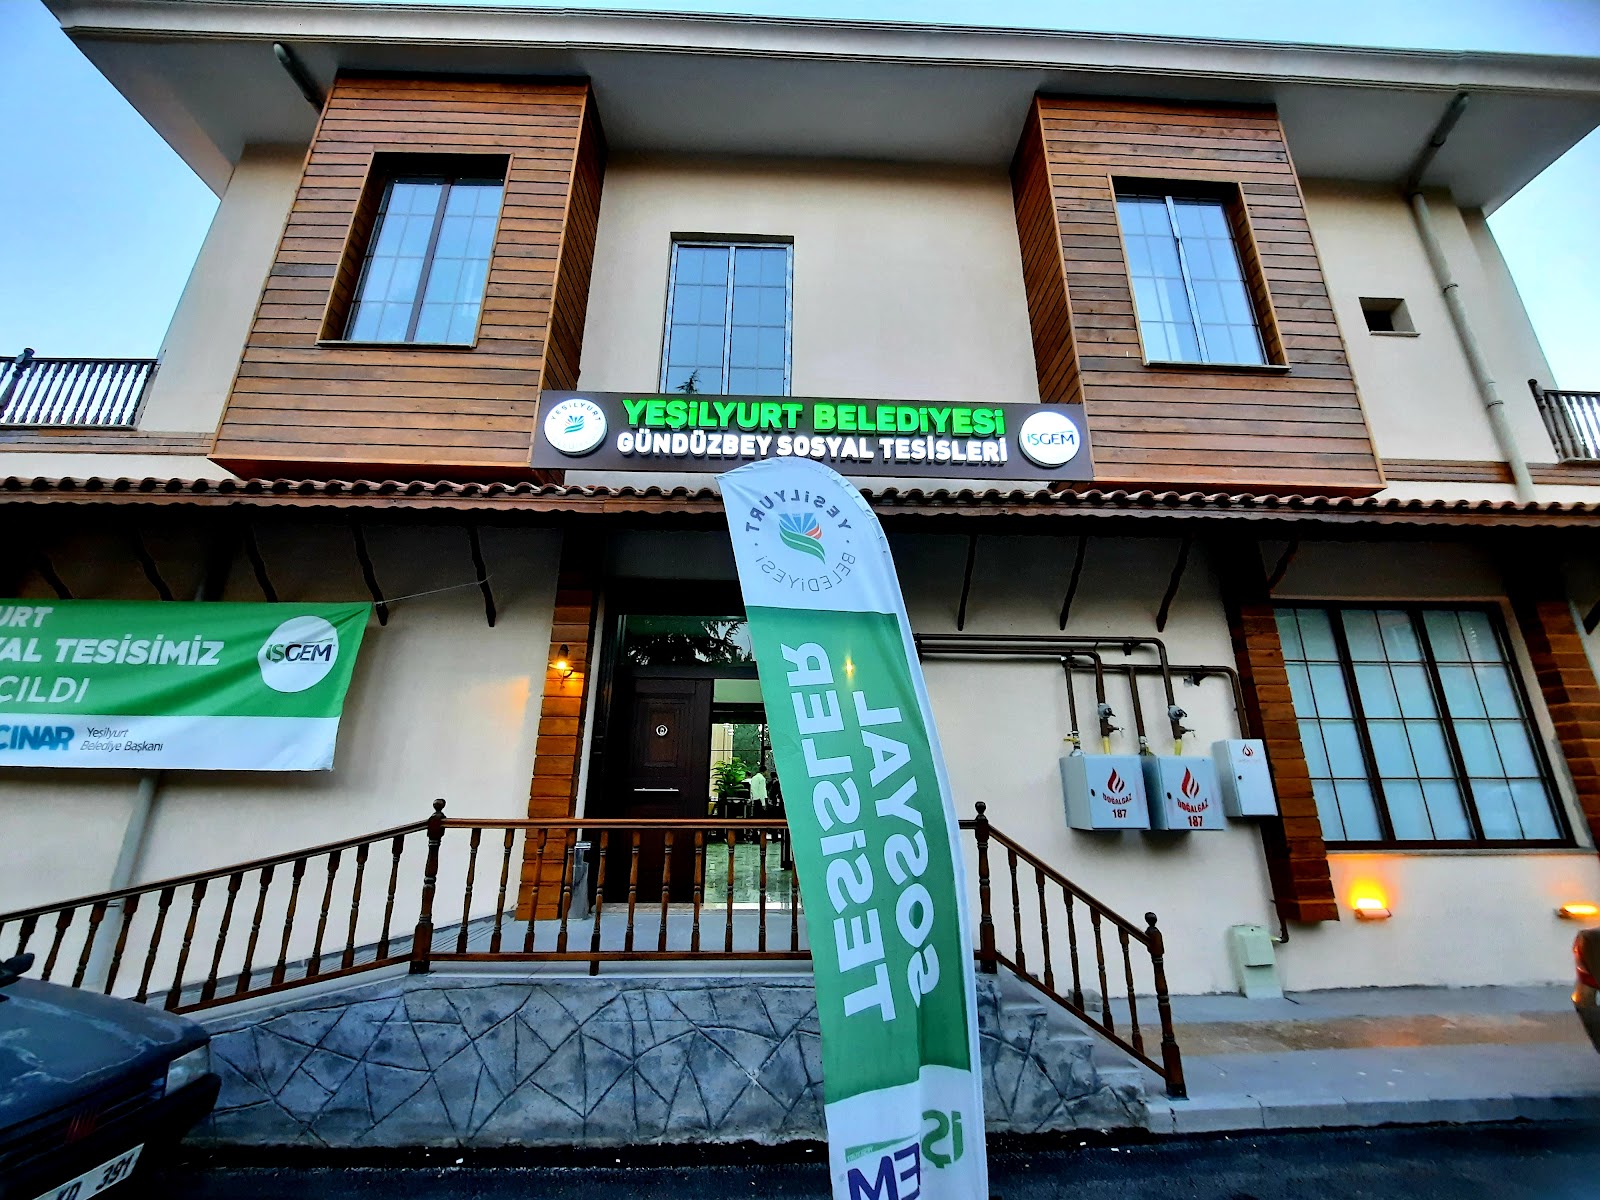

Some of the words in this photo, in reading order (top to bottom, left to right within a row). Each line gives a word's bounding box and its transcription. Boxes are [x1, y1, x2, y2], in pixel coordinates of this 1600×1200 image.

[814, 403, 1006, 437] BELEDİYESİ
[617, 428, 773, 457] GÜNDÜZBEY
[776, 435, 875, 463] SOSYAL
[879, 436, 1008, 464] TESİSLERİ
[55, 634, 224, 666] TESİSİMİZ
[80, 740, 122, 752] Belediye
[124, 741, 163, 752] Başkanı
[1112, 809, 1127, 819] 187
[1187, 815, 1203, 827] 187
